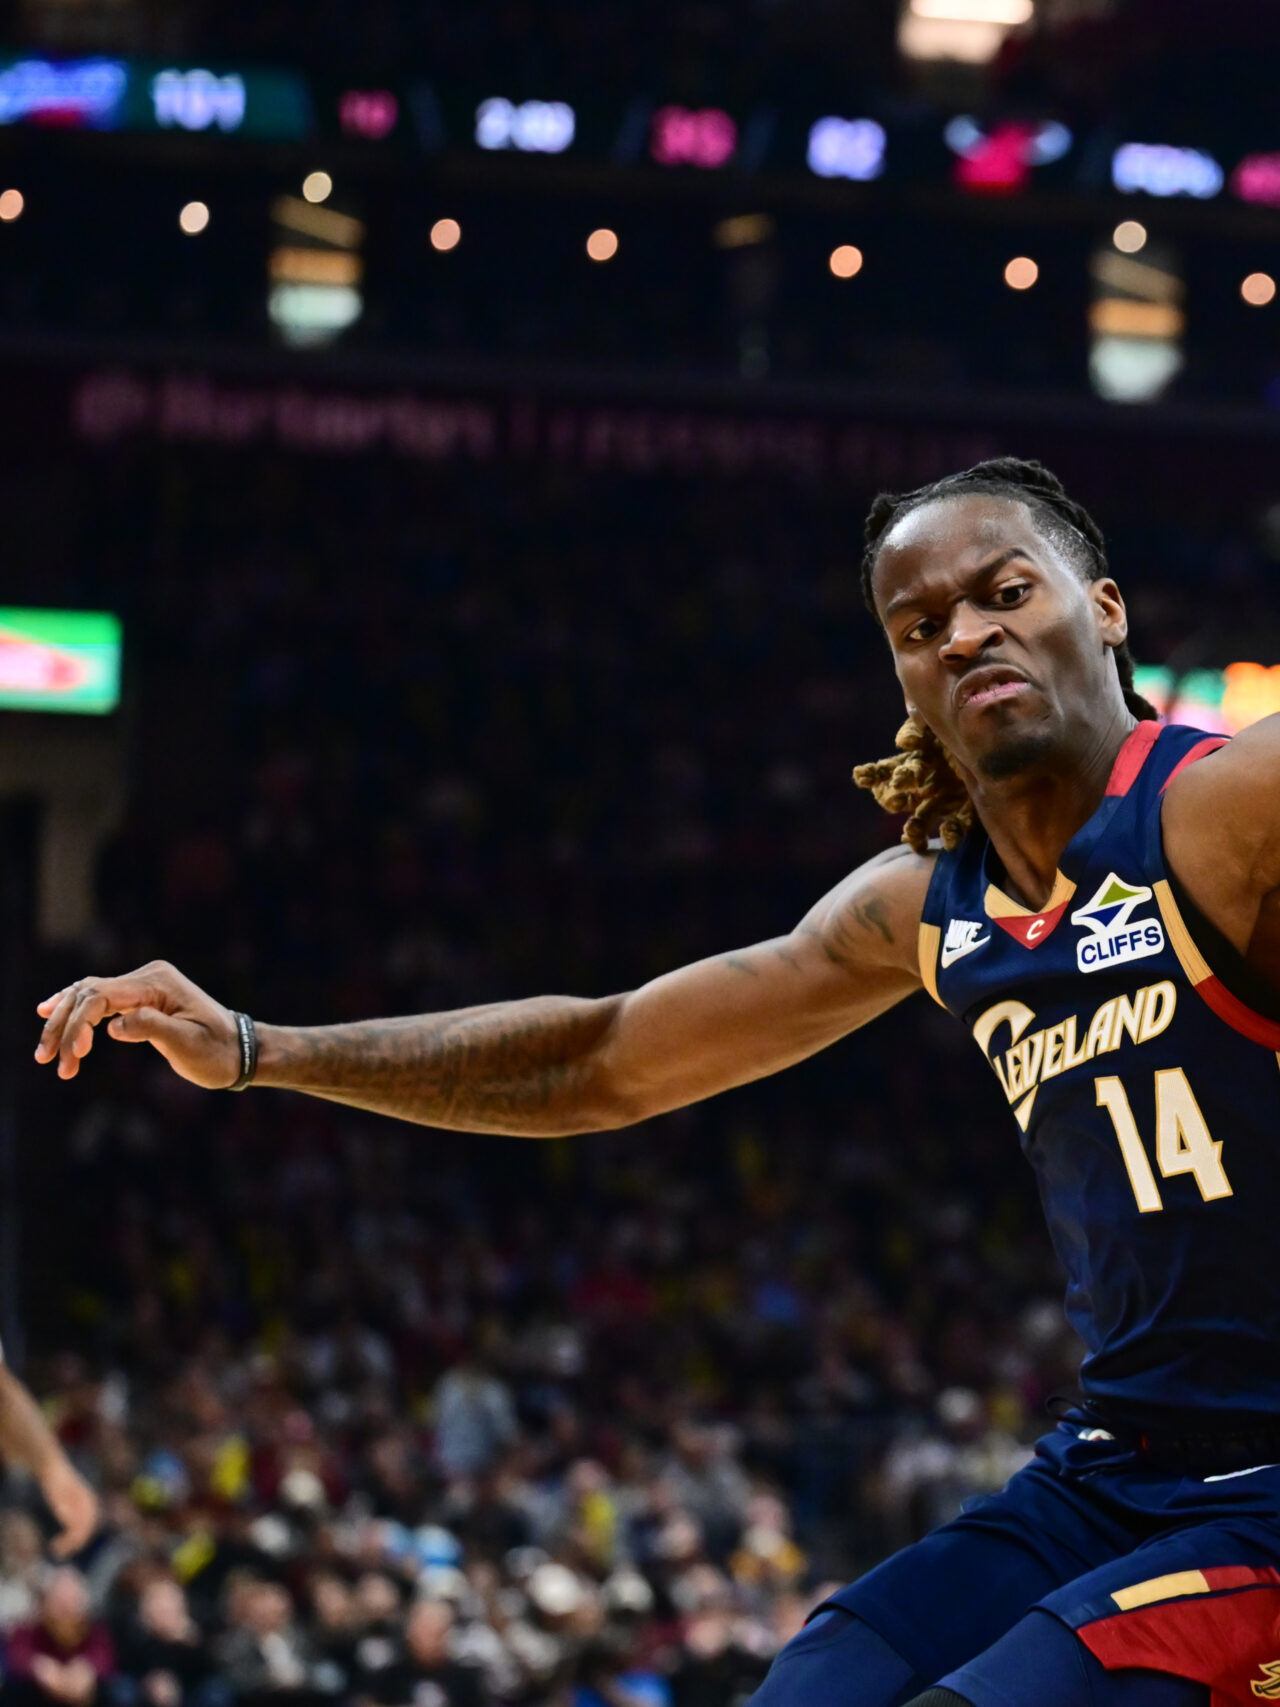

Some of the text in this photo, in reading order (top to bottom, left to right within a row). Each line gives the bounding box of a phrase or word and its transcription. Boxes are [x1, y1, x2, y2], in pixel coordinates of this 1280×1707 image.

[945, 919, 983, 949] NIKE
[1026, 919, 1046, 941] C
[1081, 925, 1161, 965] CLIFFS
[972, 980, 1177, 1133] CLEVELAND
[1094, 1066, 1234, 1214] 14
